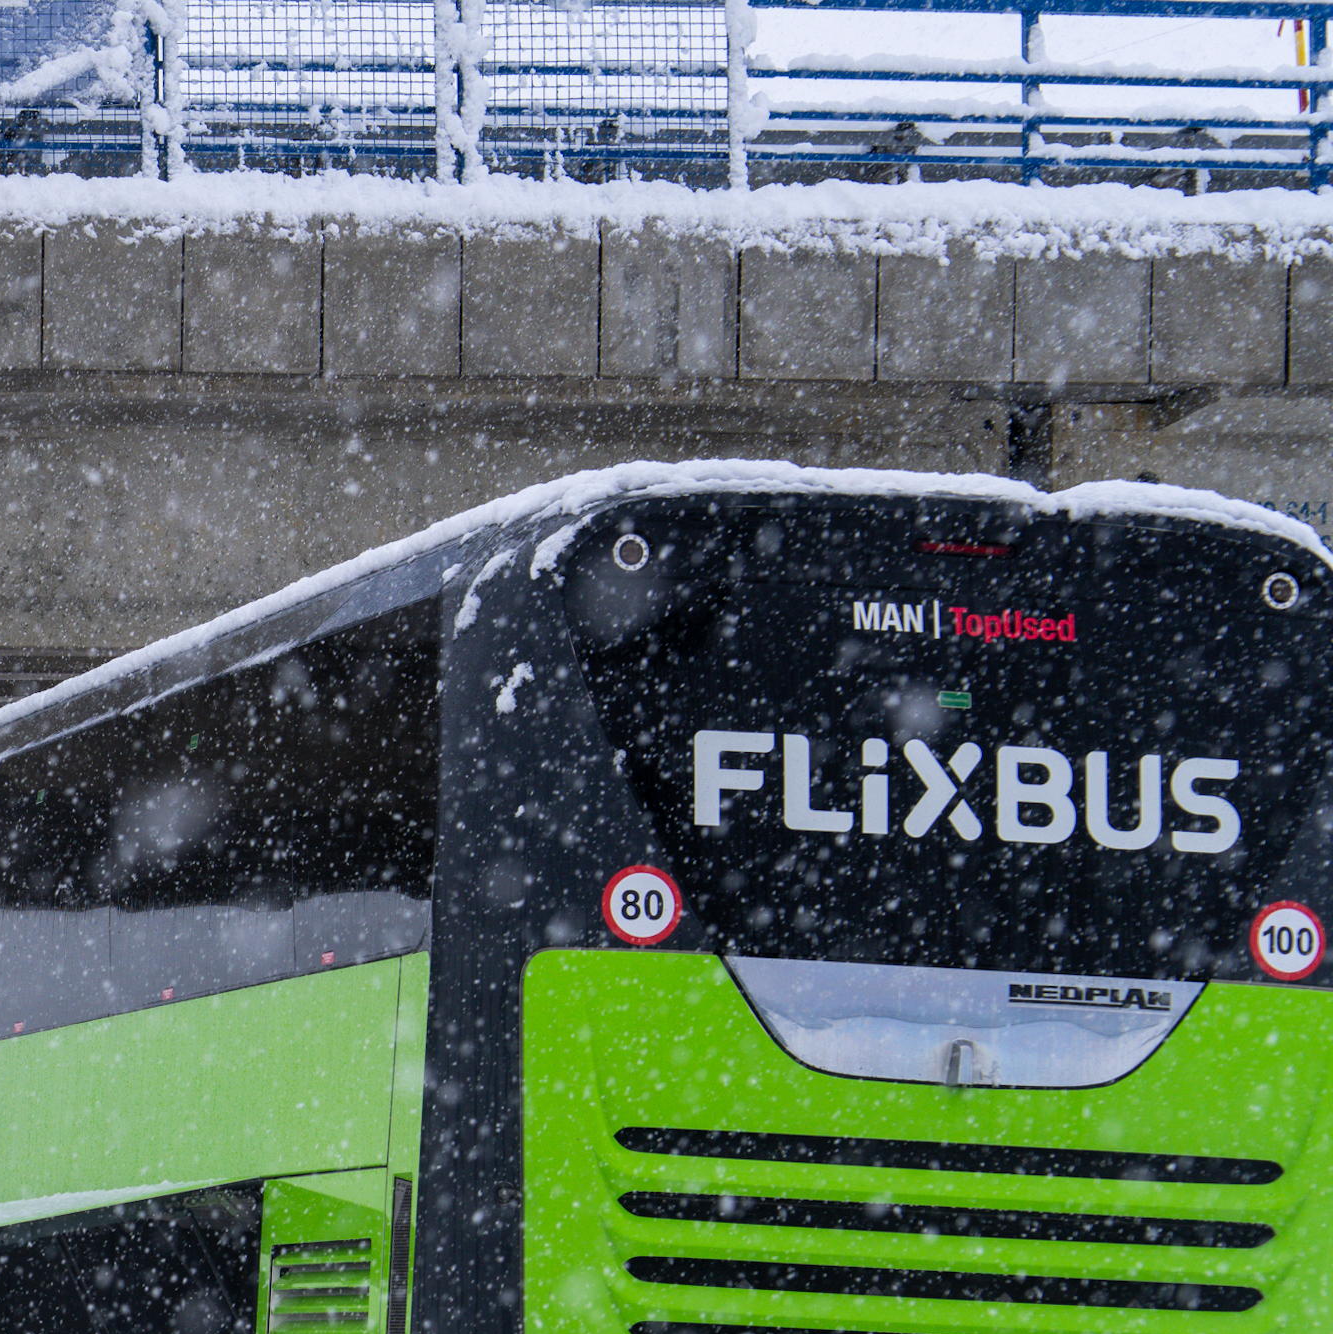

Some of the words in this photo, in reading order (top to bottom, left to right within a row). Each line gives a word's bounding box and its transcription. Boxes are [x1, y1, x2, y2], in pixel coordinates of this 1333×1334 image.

[853, 601, 924, 633] MAN
[948, 606, 1076, 643] TopUsed
[621, 889, 664, 921] 80
[1263, 925, 1314, 956] 100
[1009, 984, 1172, 1009] NEOPLAN
